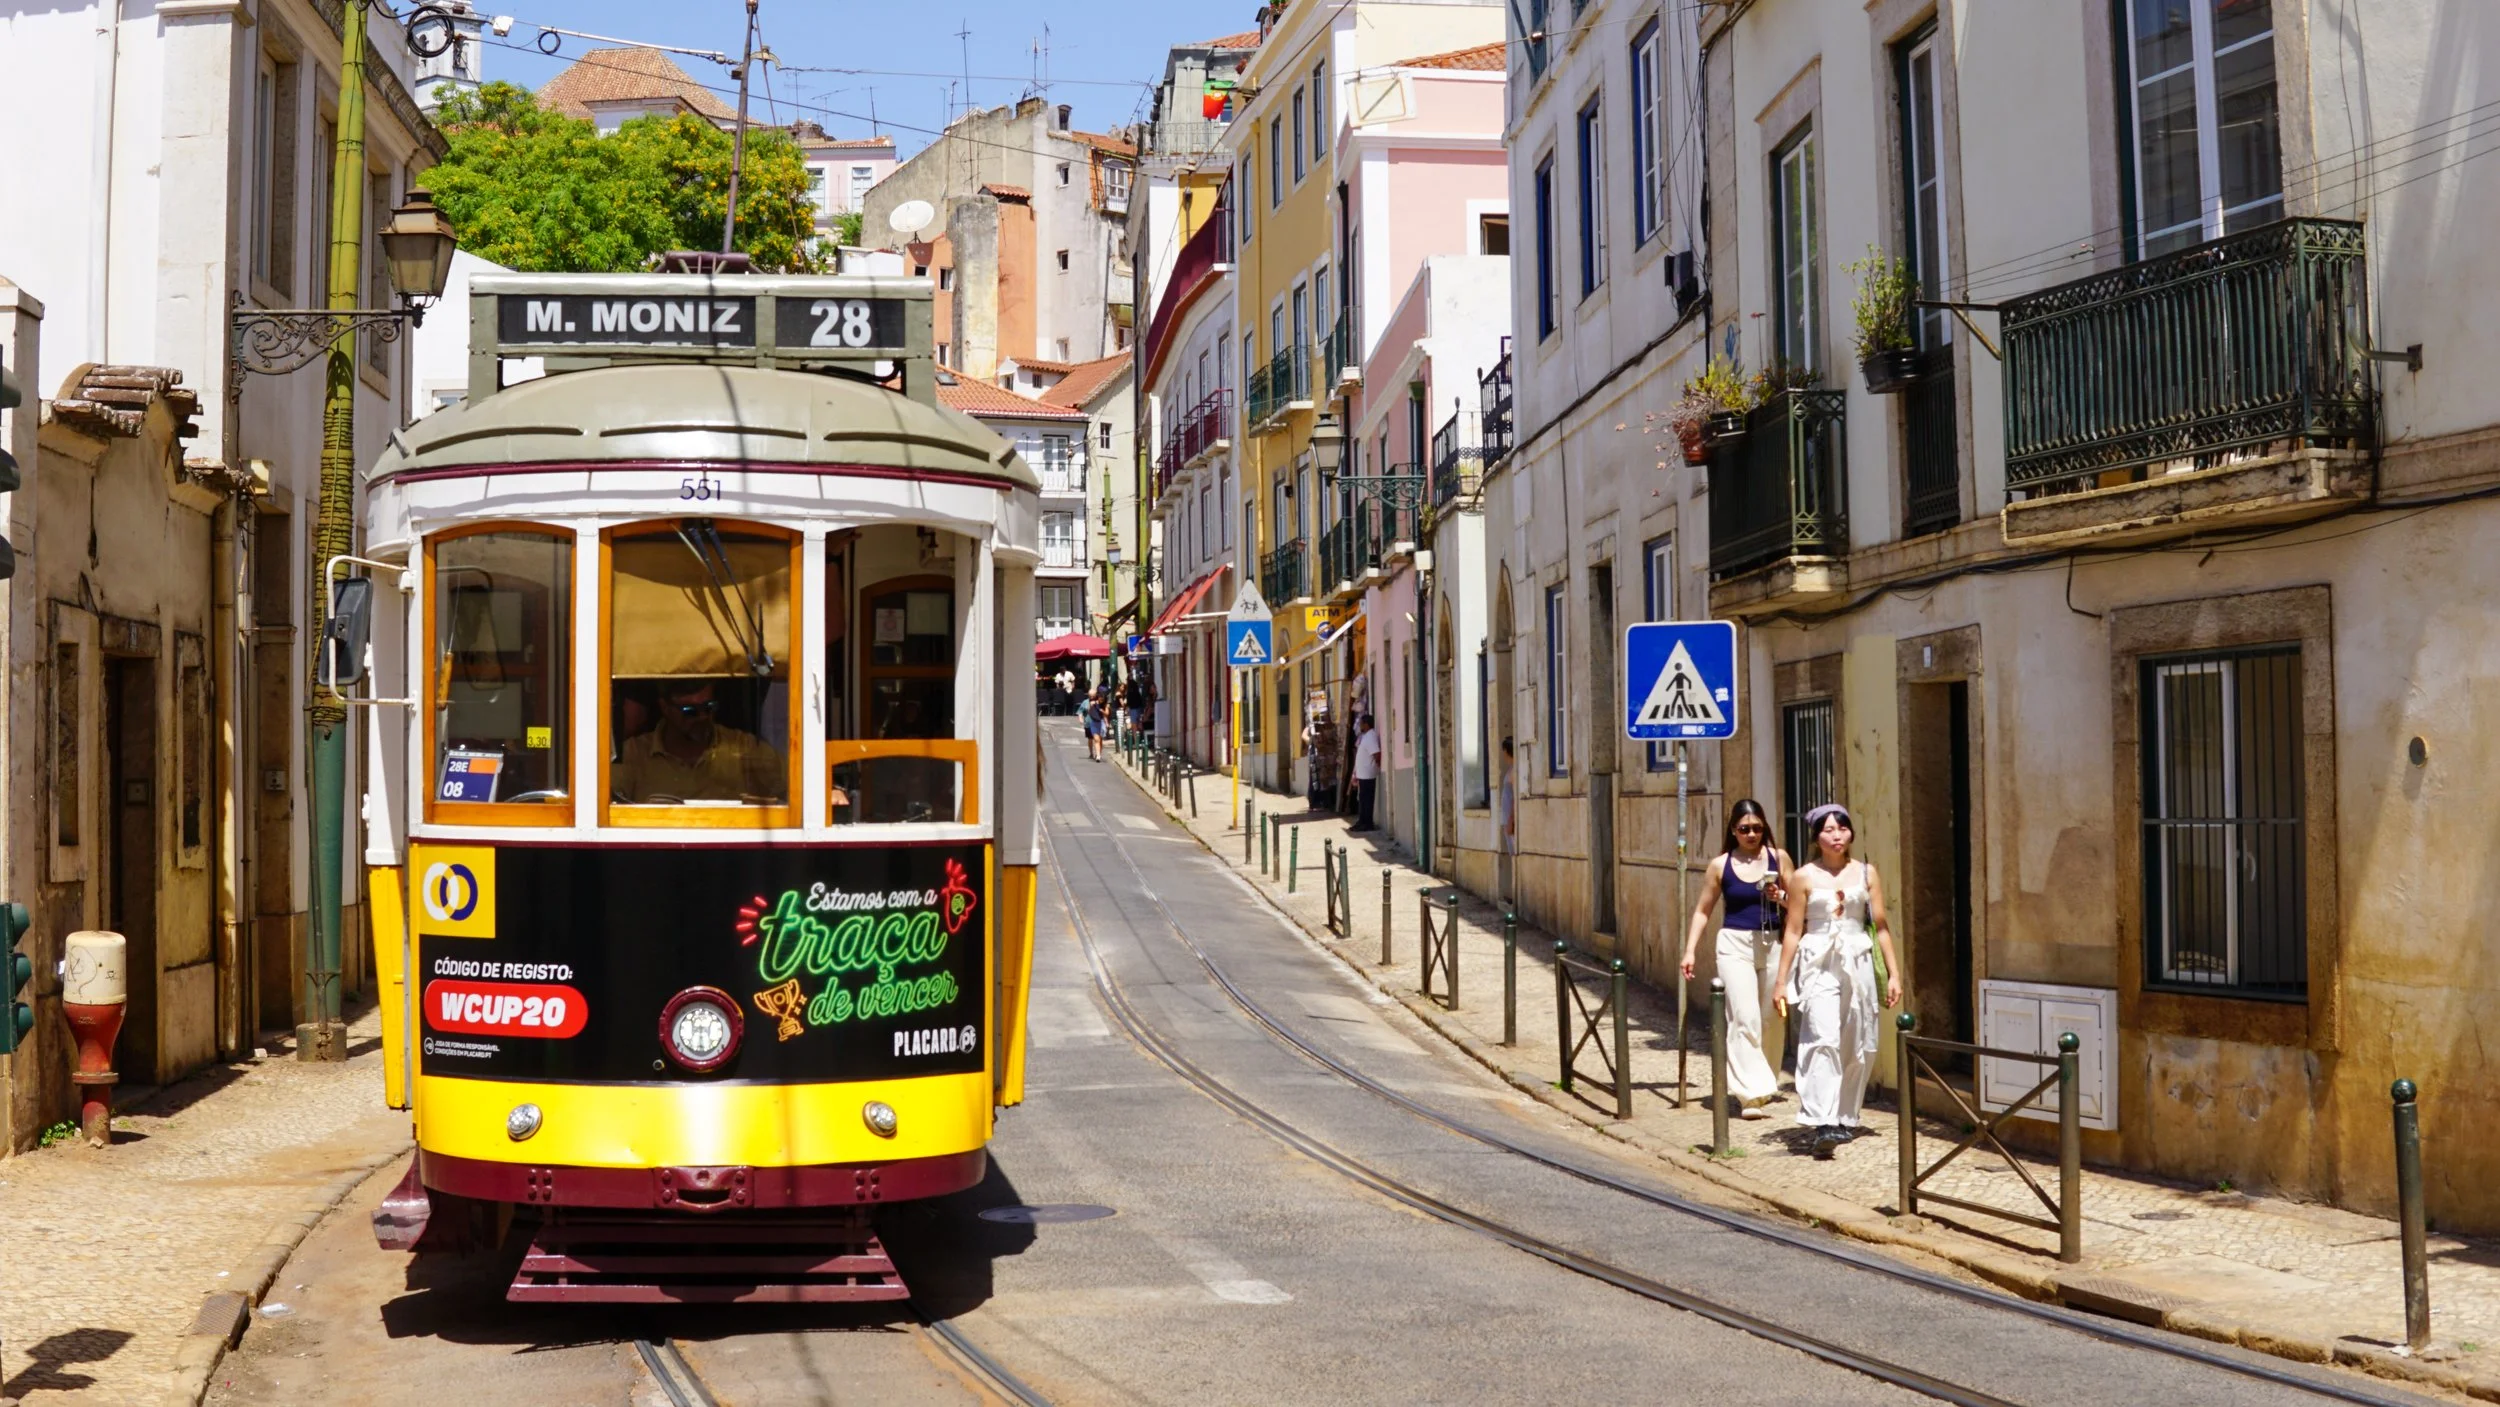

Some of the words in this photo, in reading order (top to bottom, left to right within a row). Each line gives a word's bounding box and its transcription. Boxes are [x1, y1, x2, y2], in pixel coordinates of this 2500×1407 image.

[527, 301, 576, 332] M.
[592, 301, 741, 333] MONIZ
[810, 300, 872, 347] 28
[680, 478, 721, 501] 551
[1312, 608, 1341, 617] ATM
[448, 761, 469, 773] 28E
[443, 781, 464, 798] 08
[806, 882, 886, 911] Estamos
[888, 891, 922, 909] com
[924, 888, 938, 905] a
[760, 890, 948, 983] traça
[434, 957, 480, 977] CÓDIGO
[481, 962, 501, 978] DE
[503, 962, 573, 981] REGISTO:
[441, 992, 567, 1027] WCUP20
[808, 976, 854, 1025] de
[857, 970, 959, 1020] vencer
